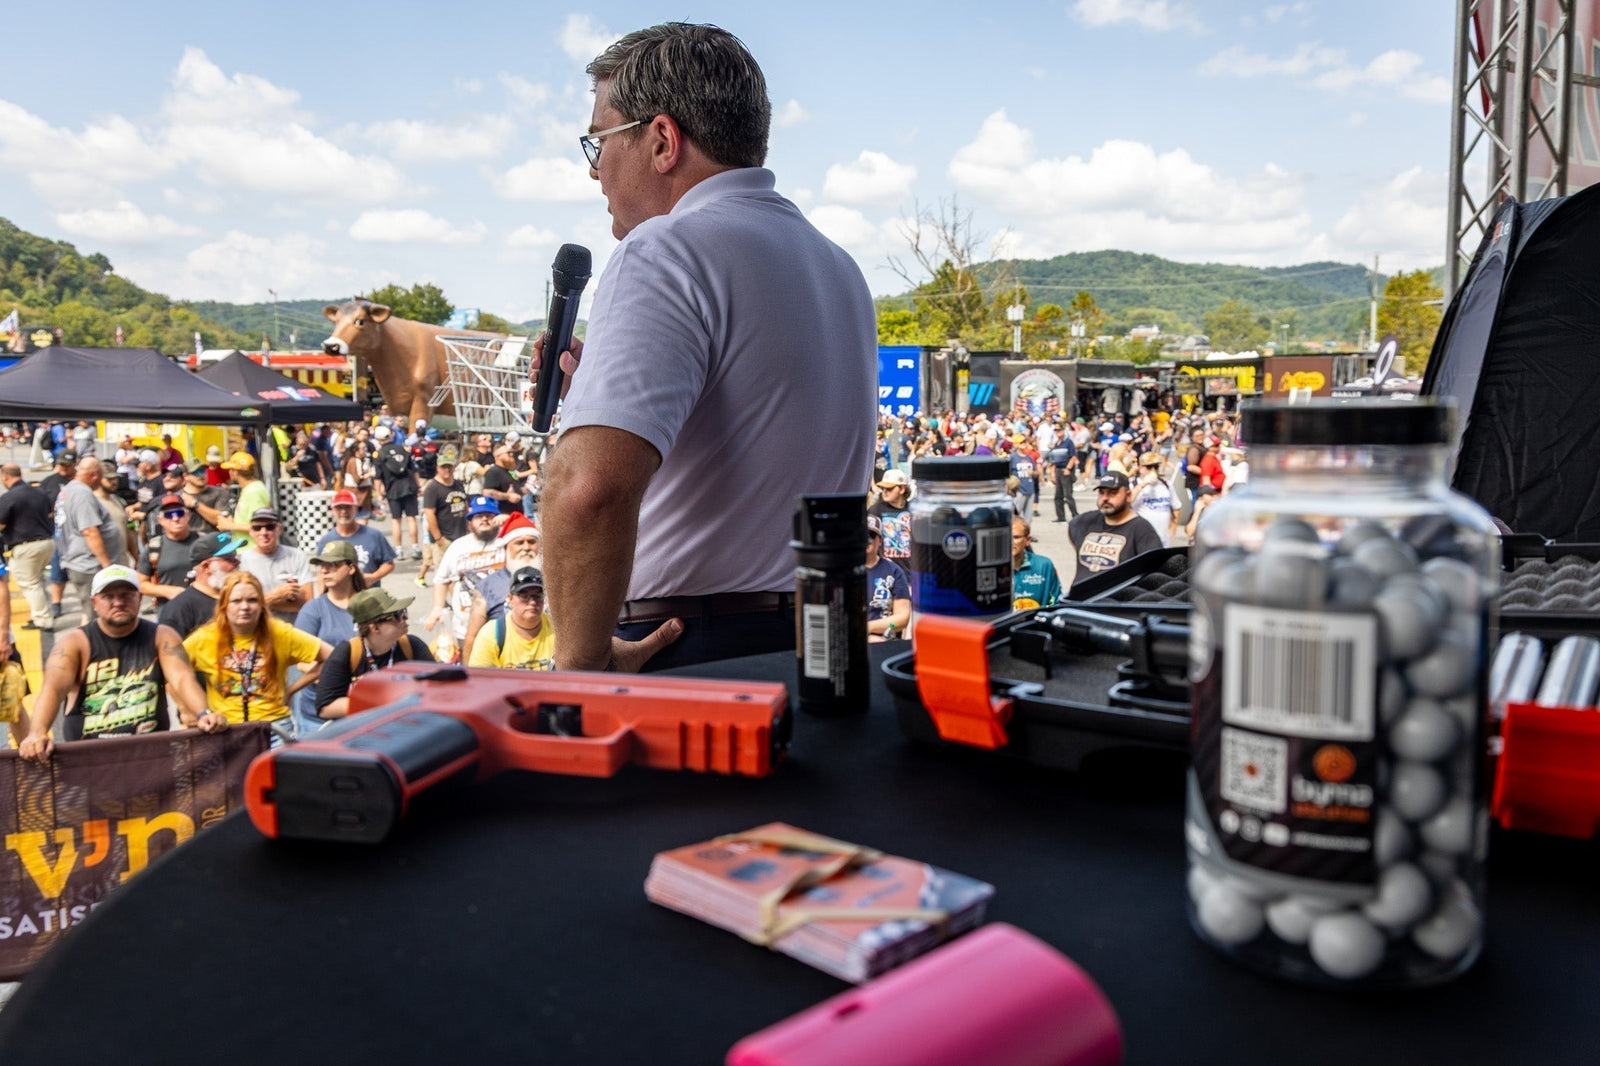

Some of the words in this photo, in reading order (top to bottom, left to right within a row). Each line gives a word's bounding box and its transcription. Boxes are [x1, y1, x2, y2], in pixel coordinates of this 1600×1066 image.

[1083, 543, 1098, 553] KYLE
[1099, 546, 1117, 556] BUSCH
[86, 658, 119, 685] 12
